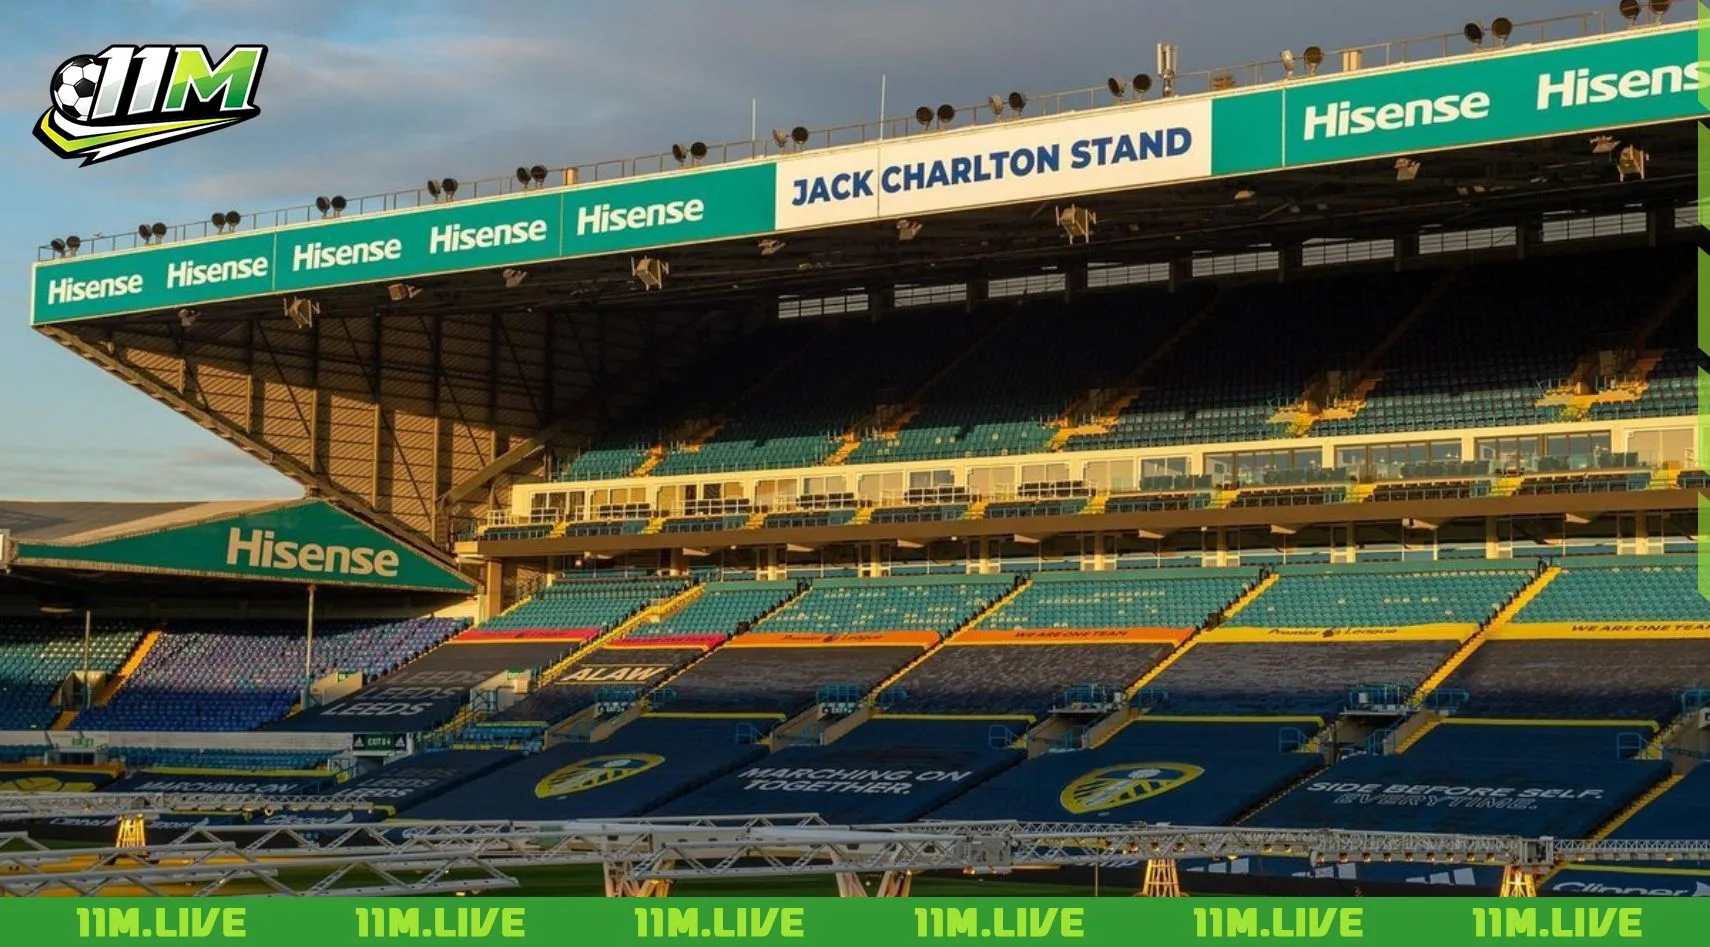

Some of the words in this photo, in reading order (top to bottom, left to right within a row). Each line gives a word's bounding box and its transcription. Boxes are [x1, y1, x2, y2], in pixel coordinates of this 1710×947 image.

[1303, 90, 1491, 141] Hisense
[792, 169, 875, 207] JACK
[880, 143, 1060, 195] CHARLTON
[1070, 126, 1192, 169] STAND
[576, 197, 705, 237] Hisense
[429, 219, 548, 255] Hisense
[292, 237, 402, 273] Hisense
[48, 272, 143, 305] Hisense
[167, 255, 269, 289] Hisense
[226, 526, 400, 577] Hisense
[560, 666, 669, 682] ALAW
[320, 702, 434, 717] LEEDS
[353, 686, 465, 700] LEEDS
[738, 767, 913, 781] MARCHING
[915, 770, 973, 782] ON
[743, 779, 913, 795] TOGETHER.
[1306, 781, 1382, 792] SIDE
[1382, 784, 1516, 798] BEFORE
